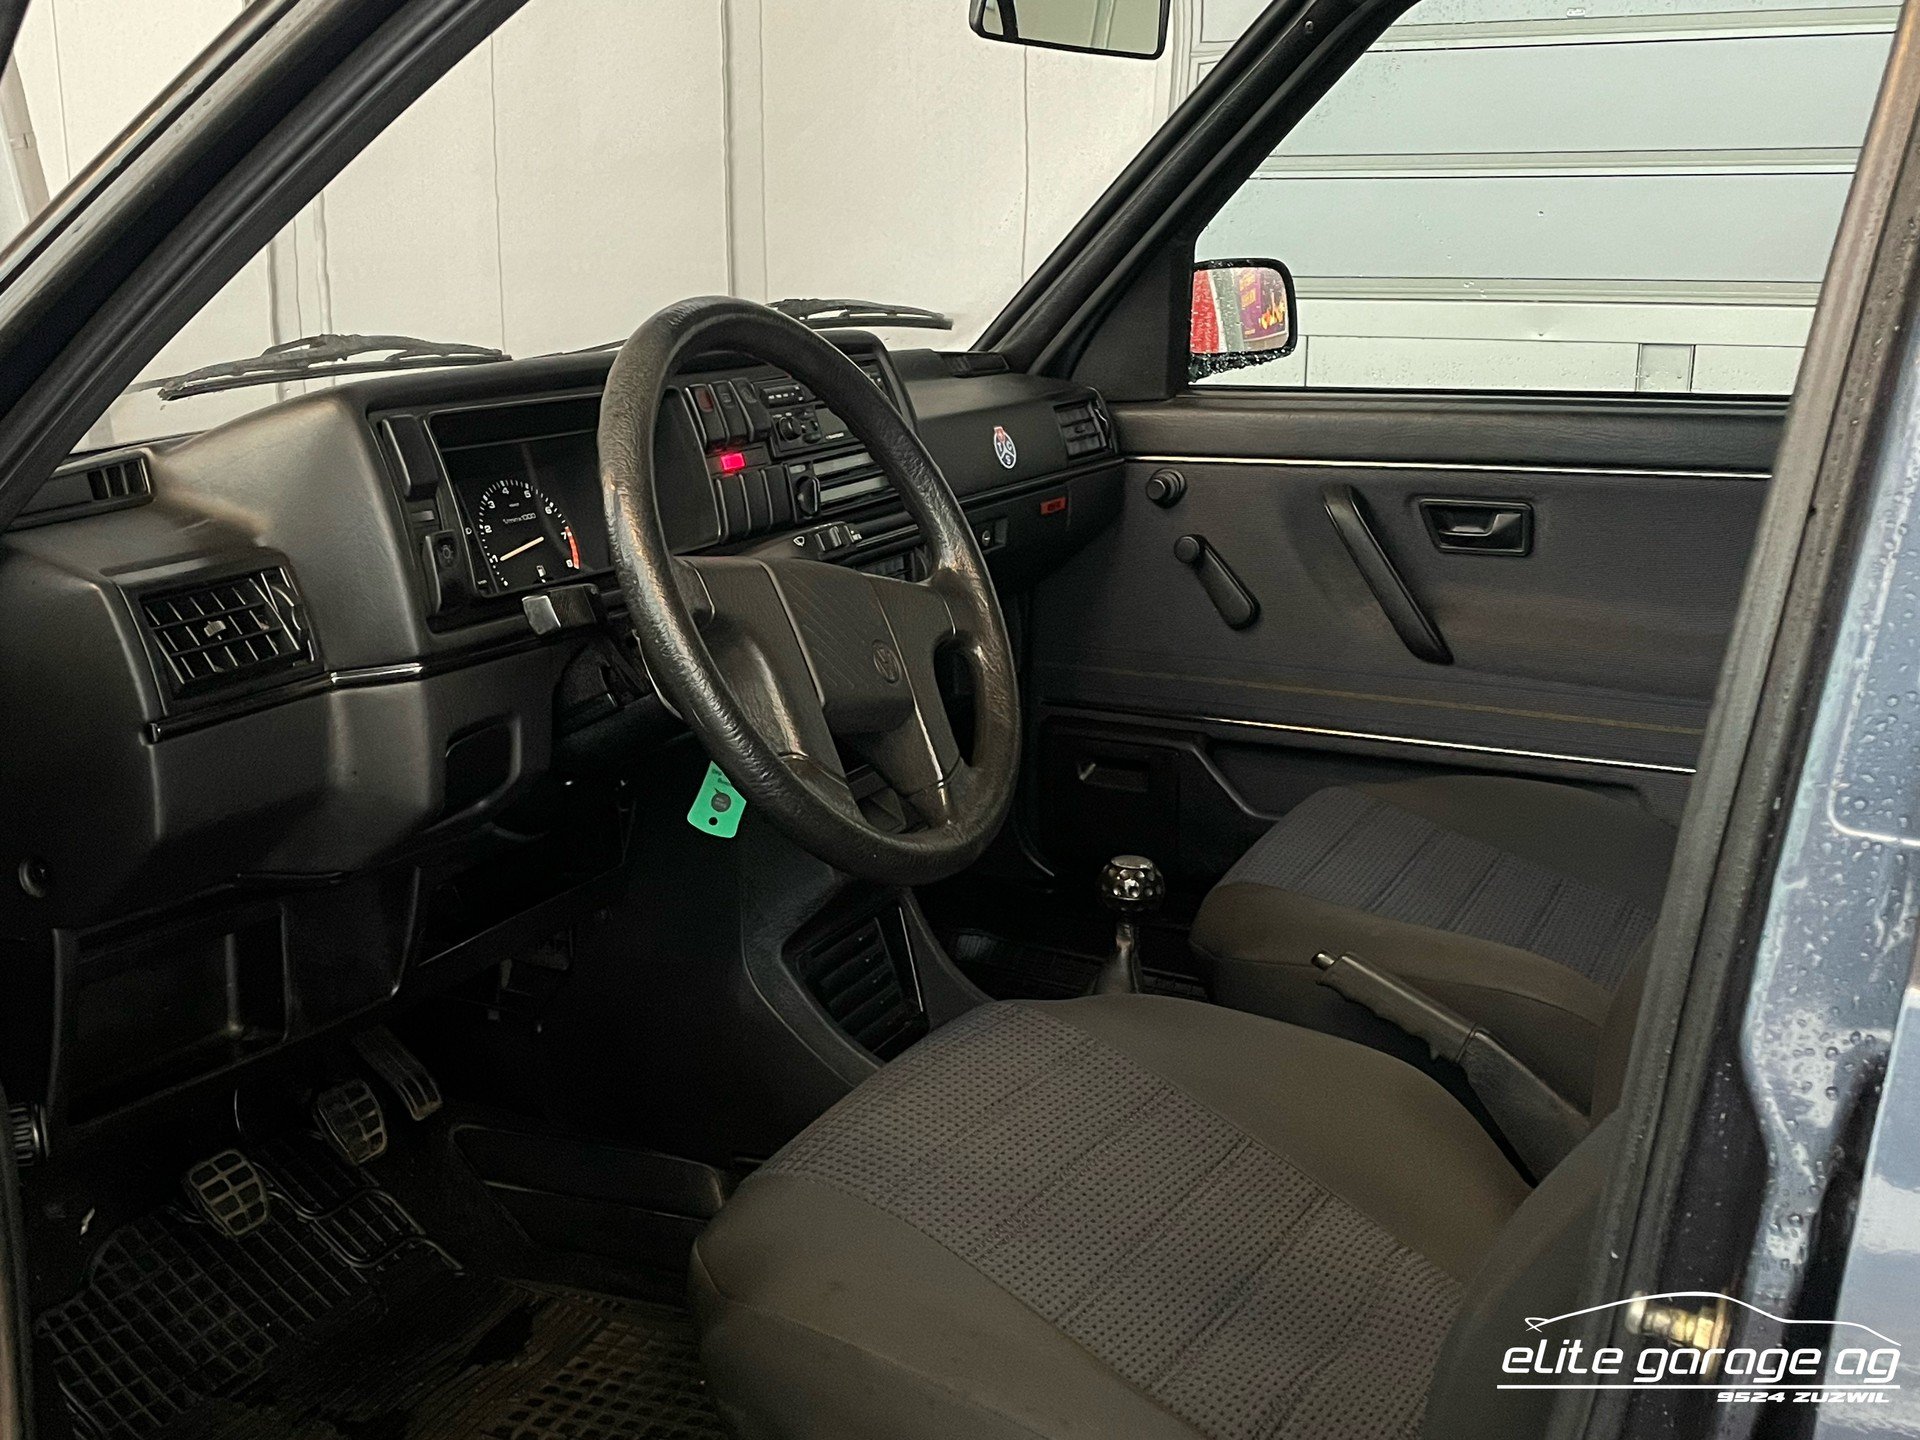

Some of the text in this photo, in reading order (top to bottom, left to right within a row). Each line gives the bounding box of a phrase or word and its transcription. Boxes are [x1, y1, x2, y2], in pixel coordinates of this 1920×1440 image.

[502, 487, 510, 495] 4
[524, 490, 532, 498] 5
[487, 501, 496, 509] 3
[545, 506, 553, 515] 6
[484, 525, 493, 534] 2
[561, 531, 568, 540] 7
